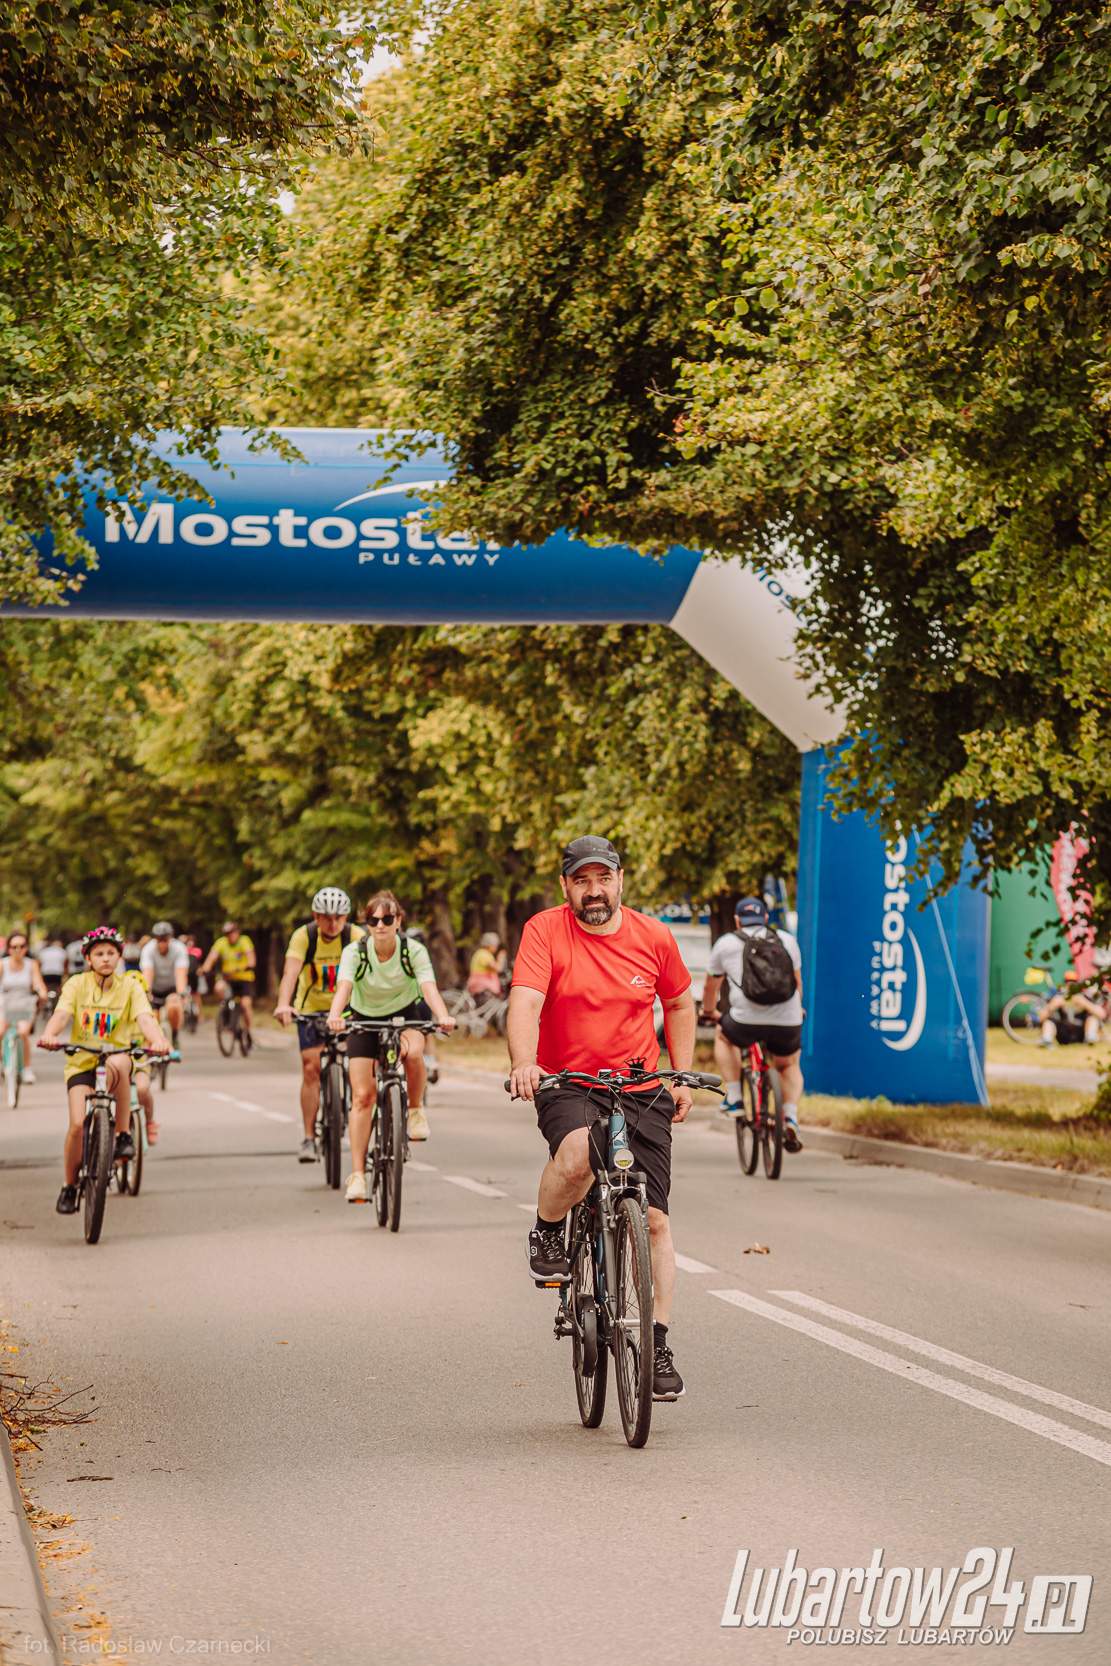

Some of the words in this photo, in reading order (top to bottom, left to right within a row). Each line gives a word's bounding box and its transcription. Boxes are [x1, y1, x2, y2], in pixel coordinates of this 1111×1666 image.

[105, 501, 500, 551] Mostosta
[359, 553, 500, 566] PUŁAWY
[881, 821, 908, 1031] ostostal
